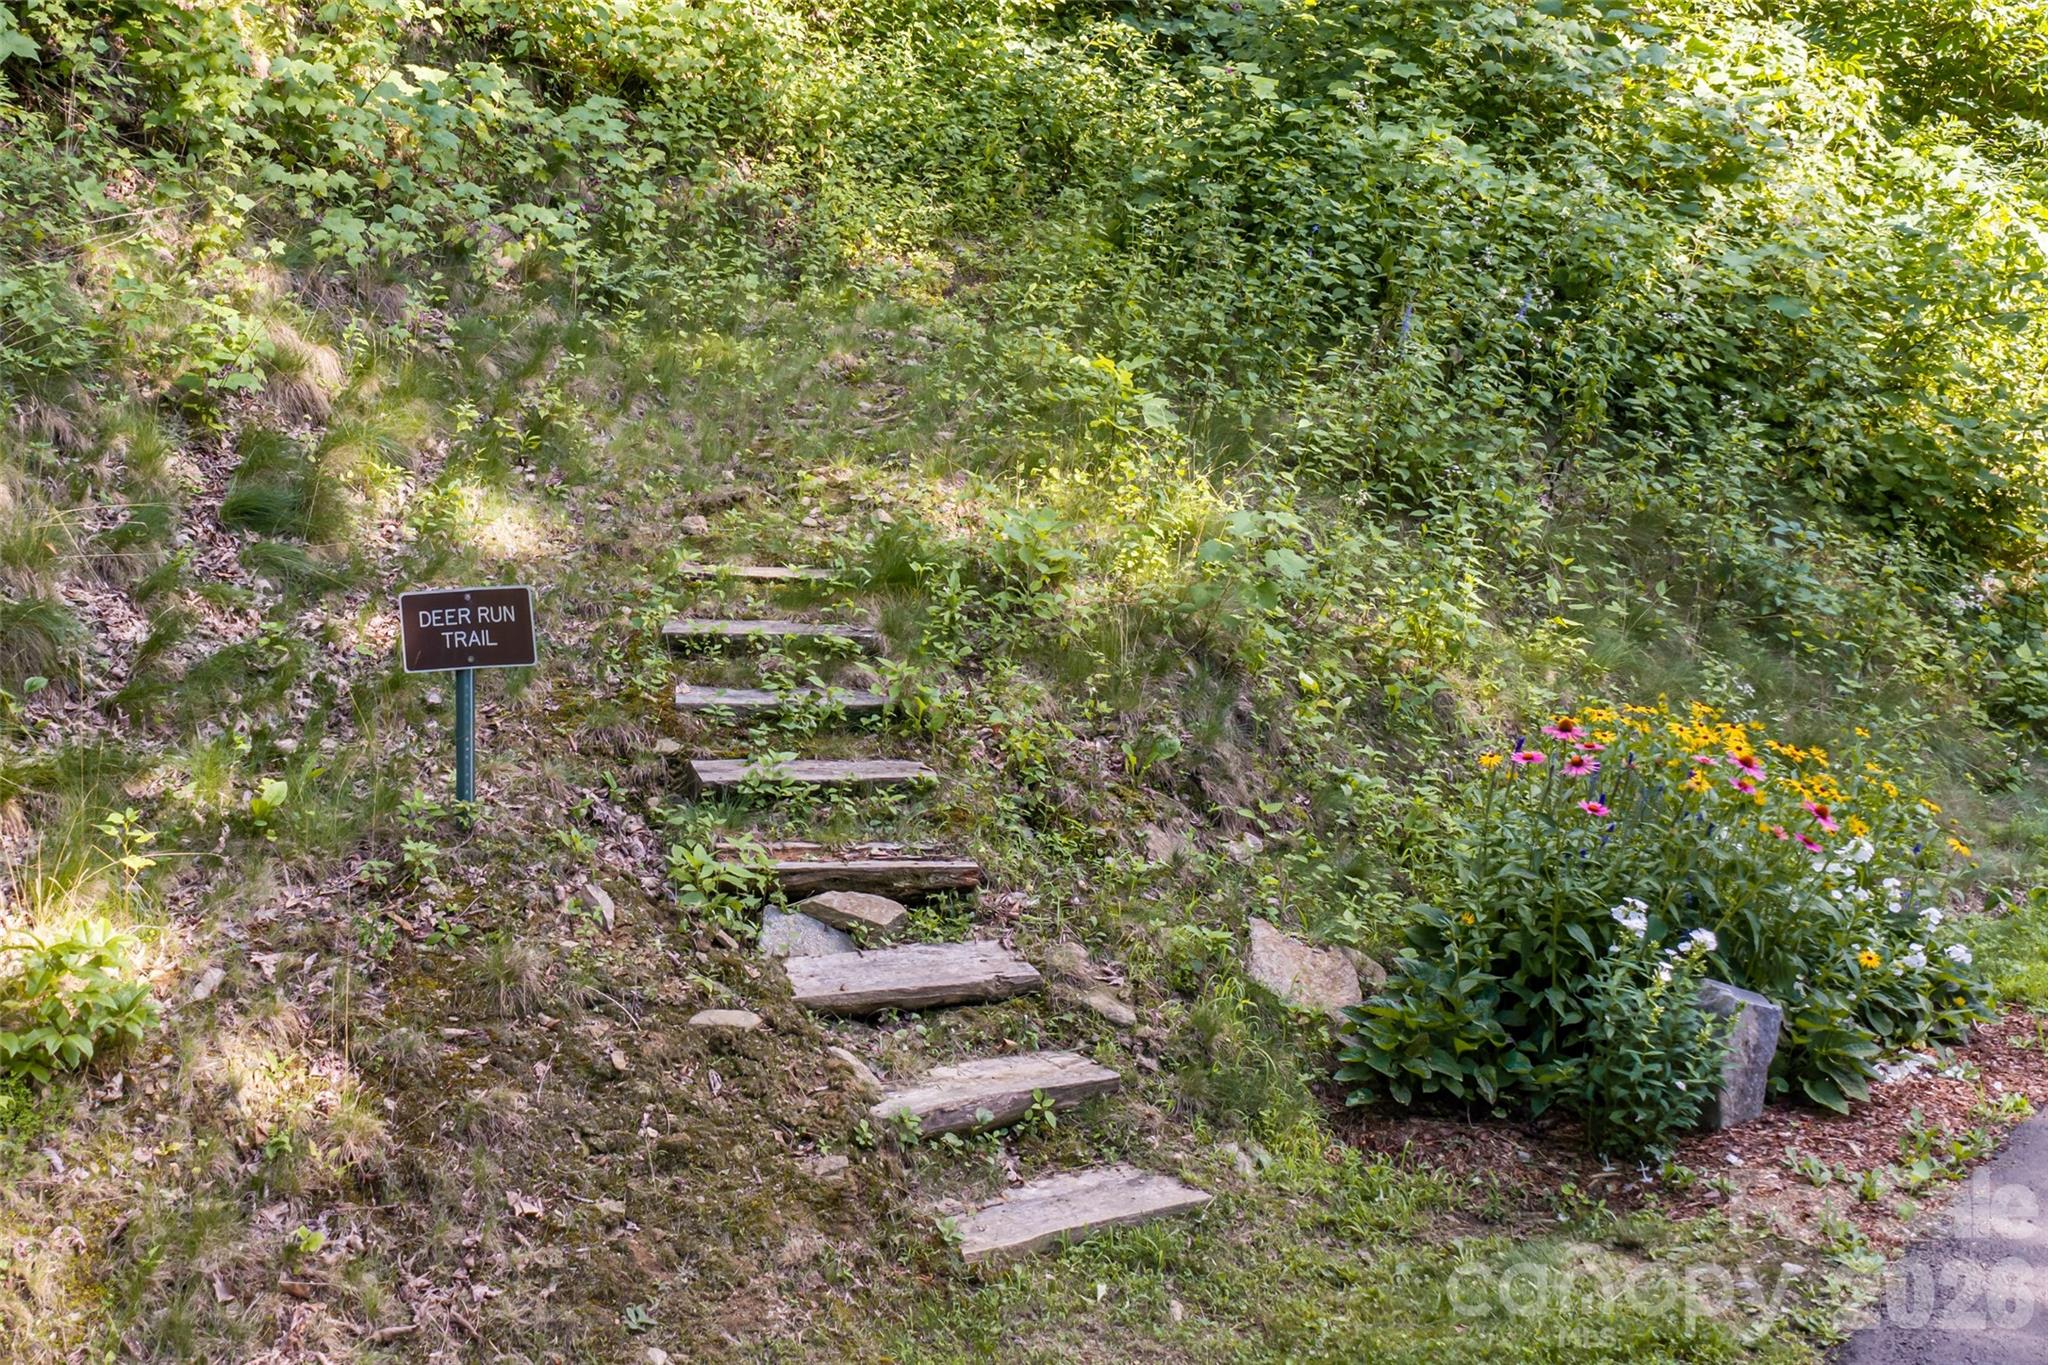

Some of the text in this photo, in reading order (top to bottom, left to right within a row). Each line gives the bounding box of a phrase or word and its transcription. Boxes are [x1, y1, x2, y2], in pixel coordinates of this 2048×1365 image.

[418, 605, 516, 628] DEER RUN
[440, 629, 499, 649] TRAIL
